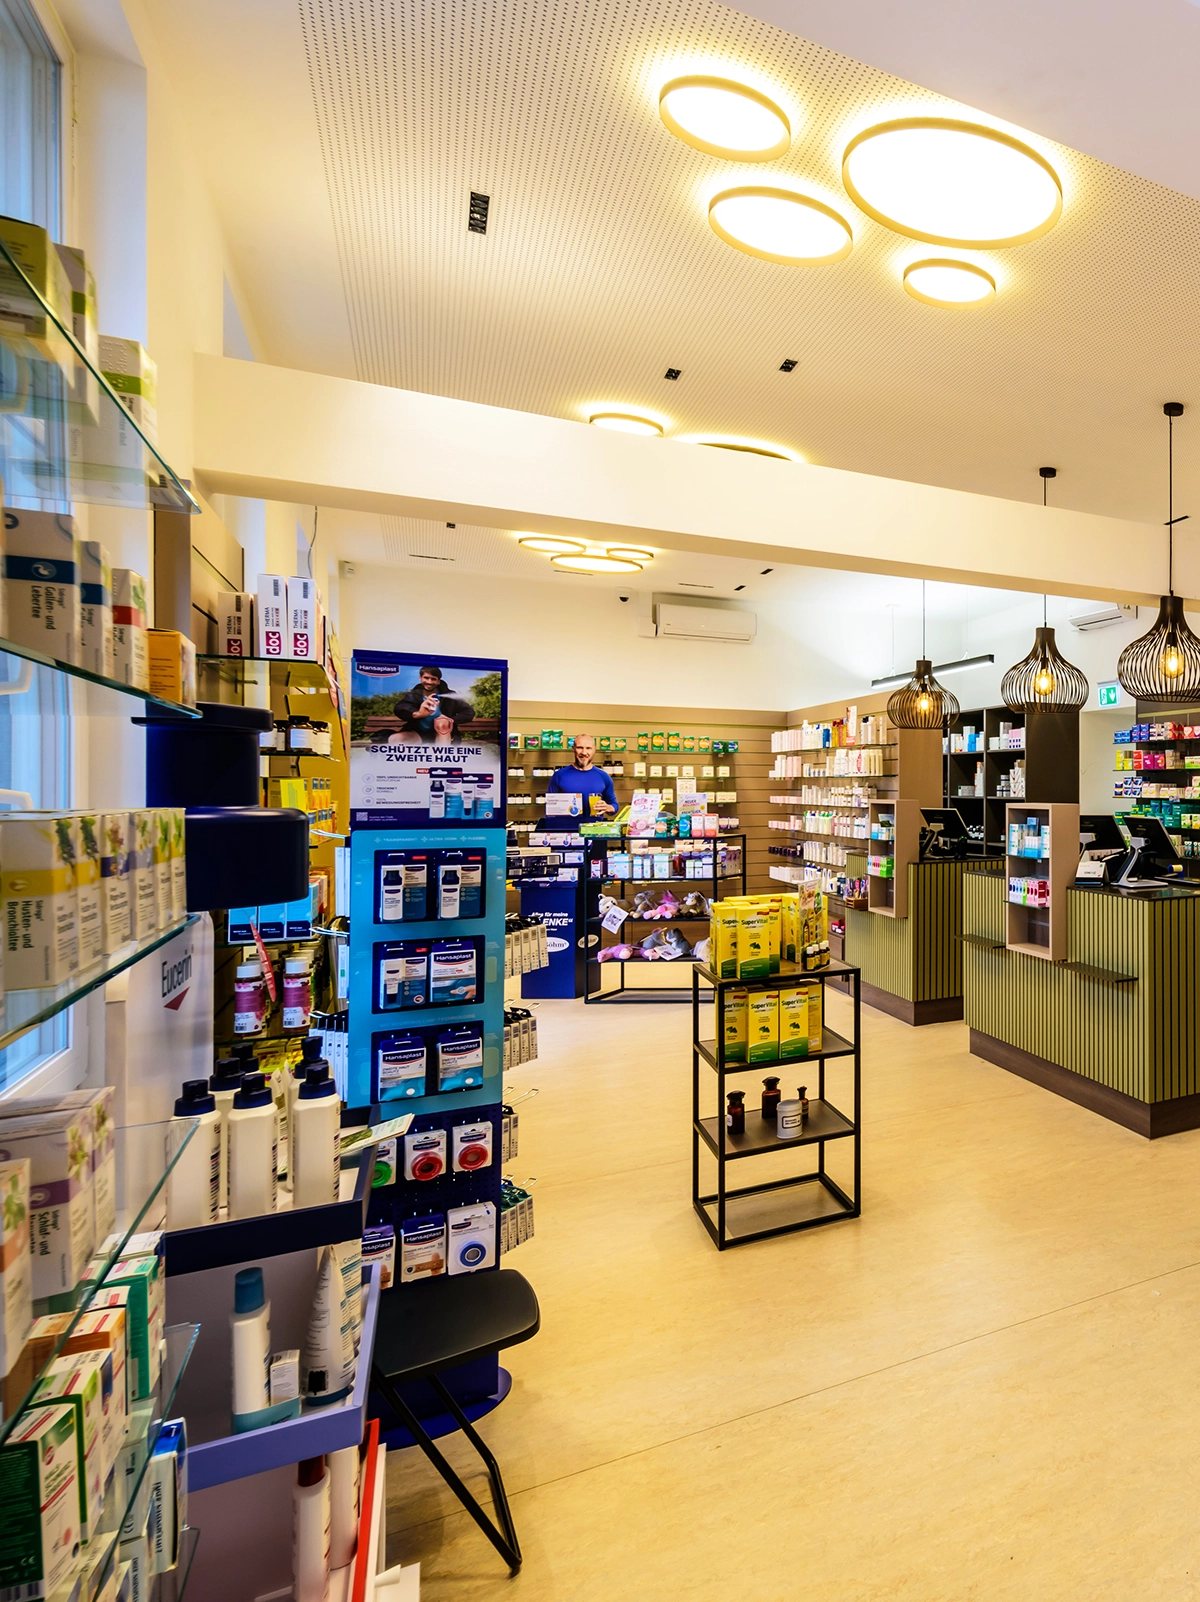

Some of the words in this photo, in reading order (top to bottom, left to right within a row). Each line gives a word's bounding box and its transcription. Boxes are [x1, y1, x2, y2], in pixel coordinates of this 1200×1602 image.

[31, 585, 42, 619] Lebertee
[45, 615, 56, 630] und
[266, 632, 280, 654] doc
[294, 634, 307, 656] doc
[358, 664, 397, 673] Hansaplast
[371, 743, 428, 754] SCHÜTZT
[432, 746, 455, 755] WIE
[457, 747, 482, 756] EINE
[386, 754, 432, 763] ZWEITE
[435, 755, 468, 763] HAUT
[21, 900, 32, 932] Husten-
[741, 918, 769, 926] SuperVital
[22, 933, 34, 949] und
[436, 953, 472, 961] Hansaplast
[162, 949, 192, 998] Eucerin
[724, 1002, 745, 1010] perVital
[751, 1001, 778, 1010] SuperVital
[781, 998, 807, 1006] SuperVital
[443, 1043, 478, 1052] Hansaplast
[385, 1052, 422, 1061] Hansaplast
[406, 1231, 442, 1242] Hansaplast
[39, 1240, 51, 1256] und
[362, 1242, 391, 1251] nsaplast
